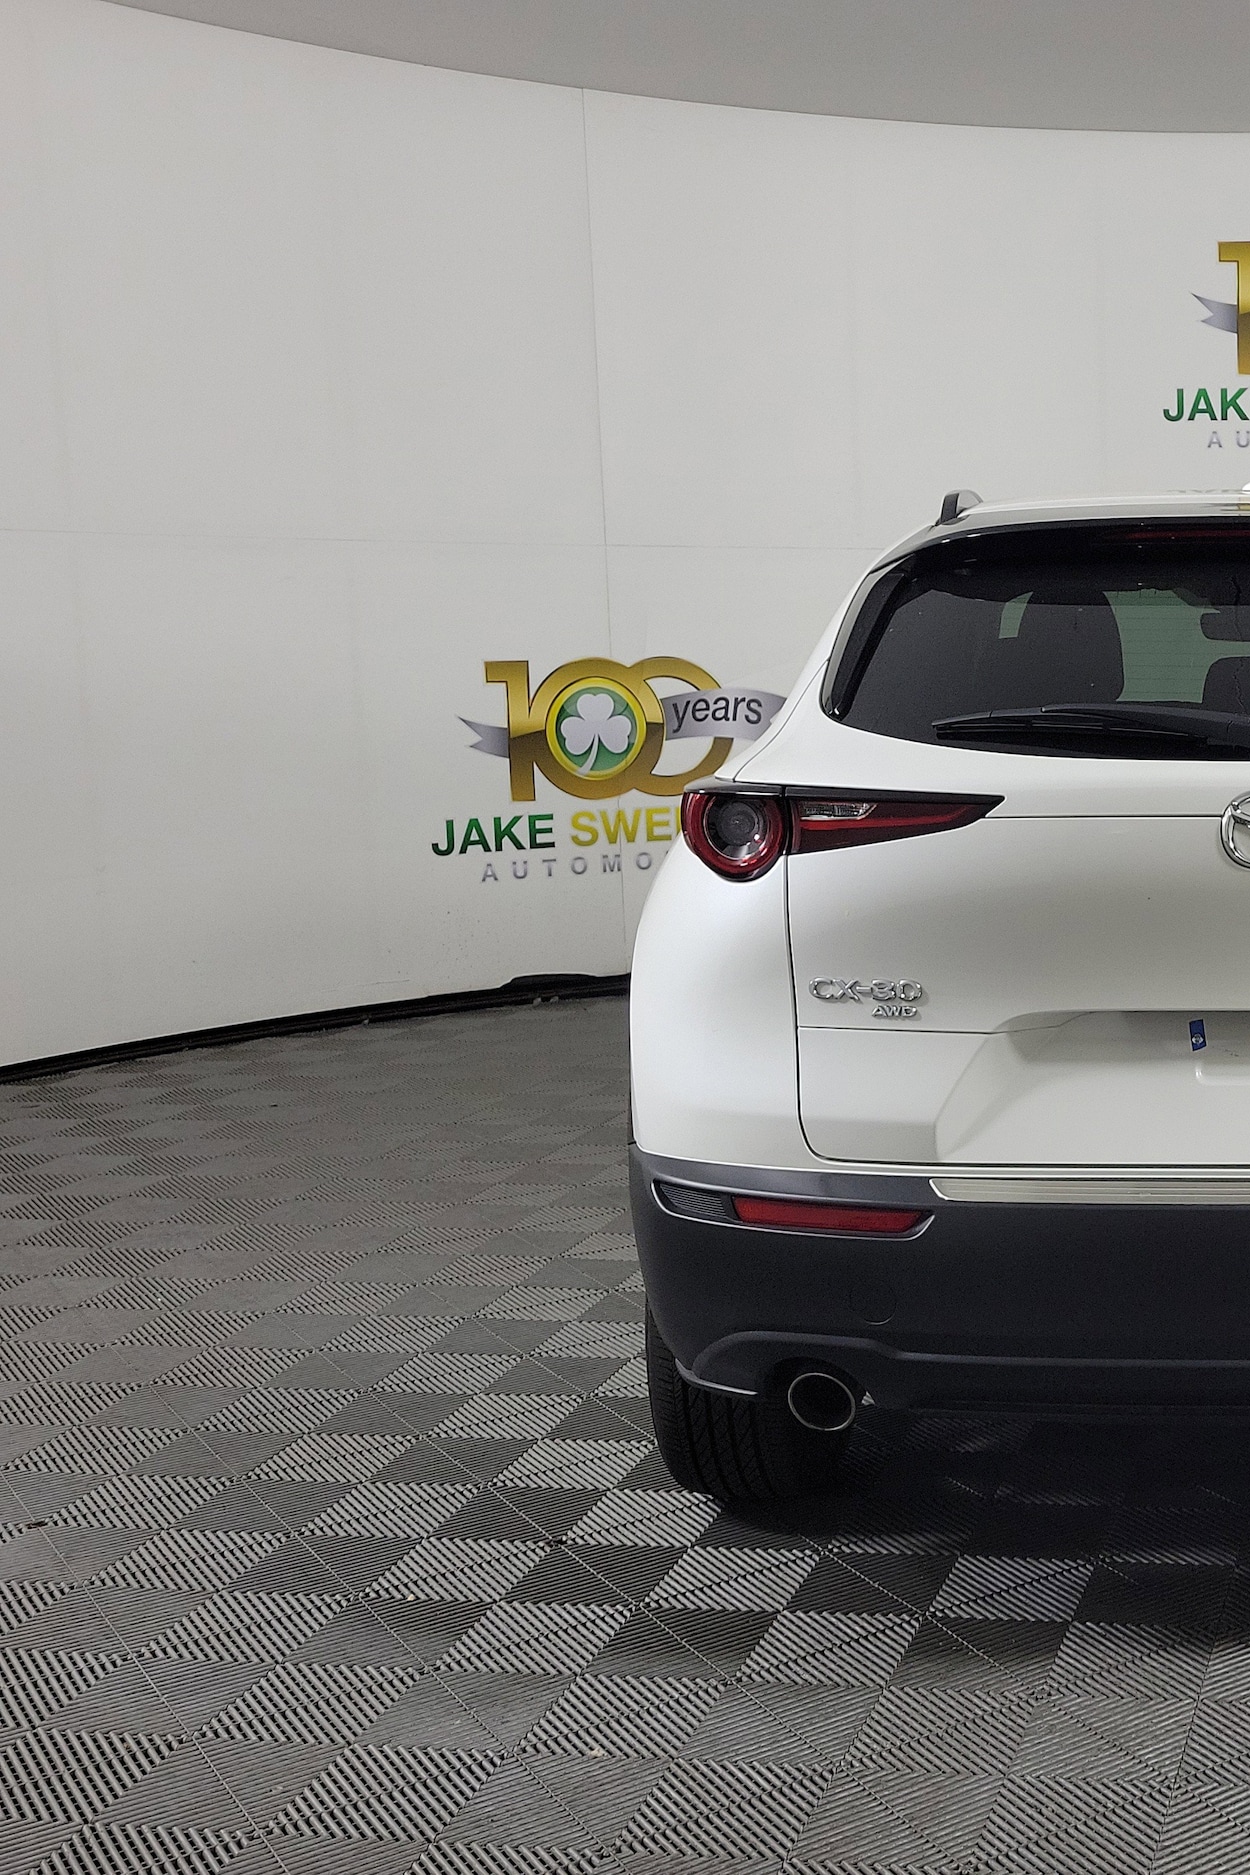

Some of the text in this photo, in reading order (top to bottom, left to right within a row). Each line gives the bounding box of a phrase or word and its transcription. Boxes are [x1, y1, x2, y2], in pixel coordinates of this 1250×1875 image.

[484, 655, 763, 802] 100 years
[431, 806, 682, 857] JAKE SWE
[481, 850, 669, 884] AUTOMO
[808, 976, 922, 1002] CX-30
[871, 1005, 918, 1018] AWD
